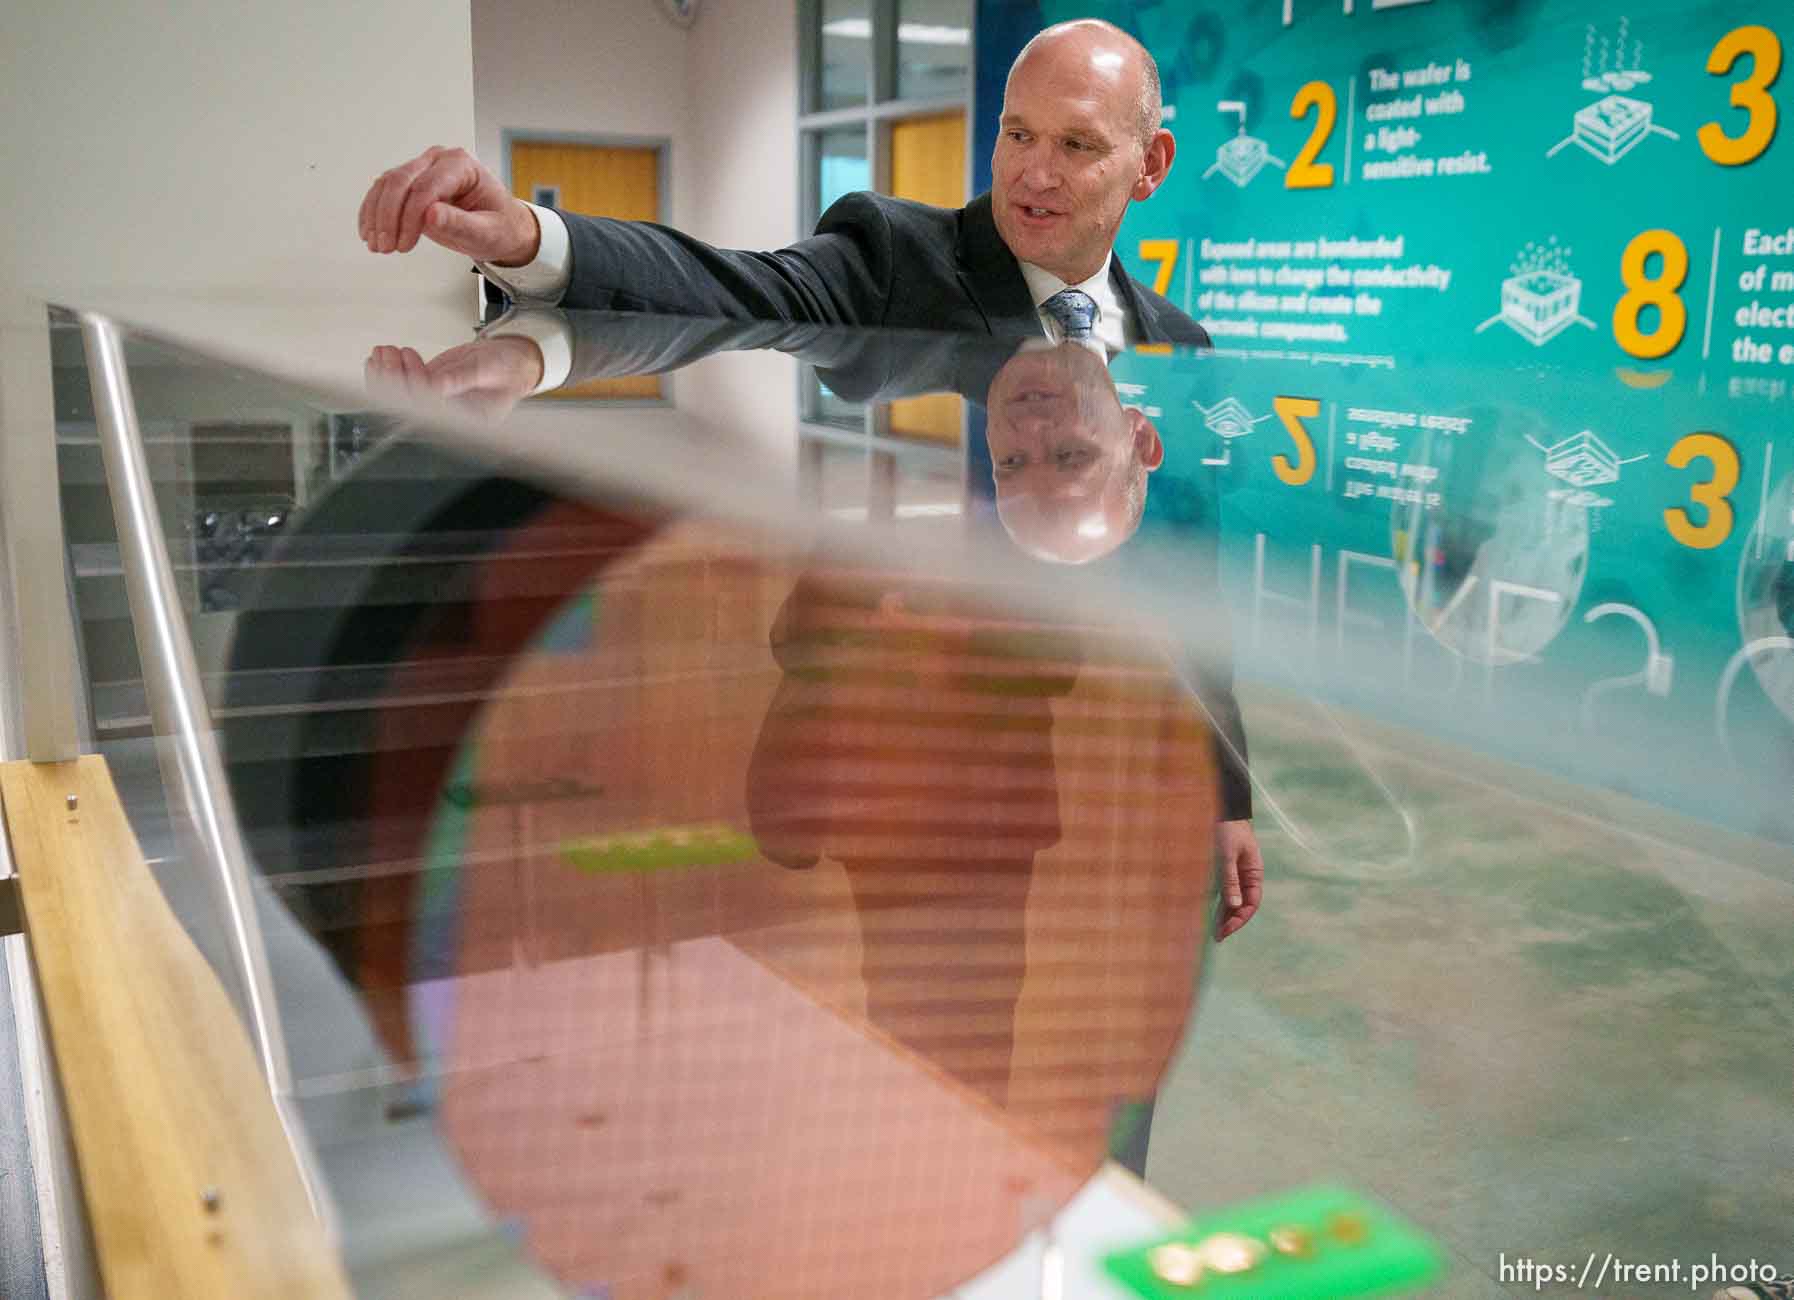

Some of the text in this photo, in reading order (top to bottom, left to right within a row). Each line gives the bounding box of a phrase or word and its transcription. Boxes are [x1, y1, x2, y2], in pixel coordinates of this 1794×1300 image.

[1369, 60, 1470, 91] The wafer is
[1366, 91, 1465, 121] coated with
[1698, 25, 1781, 166] 3
[1285, 80, 1336, 188] 2
[1364, 133, 1375, 151] a
[1363, 151, 1491, 179] sensitive resist.
[1739, 264, 1767, 292] of
[1612, 228, 1688, 360] 8
[1732, 337, 1772, 363] the
